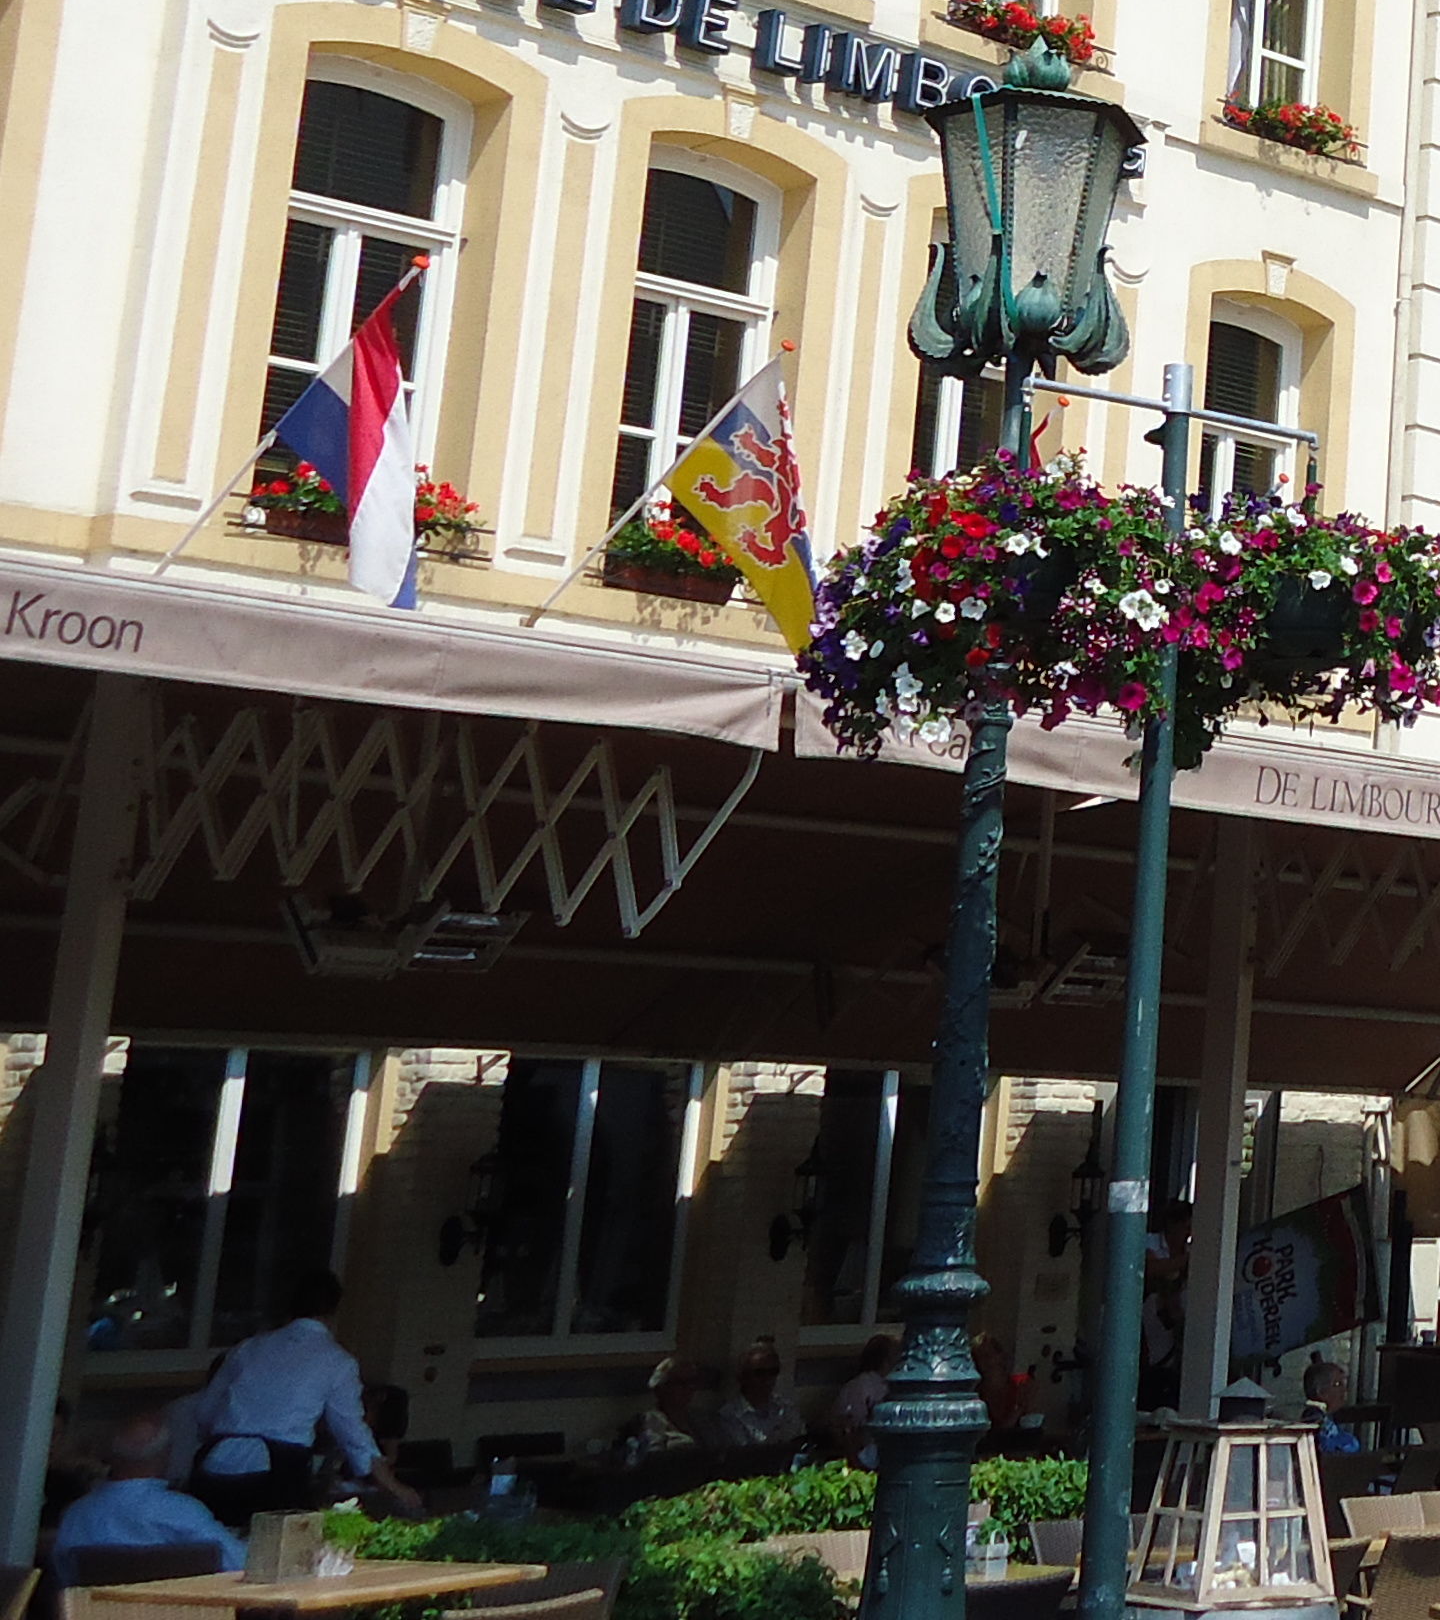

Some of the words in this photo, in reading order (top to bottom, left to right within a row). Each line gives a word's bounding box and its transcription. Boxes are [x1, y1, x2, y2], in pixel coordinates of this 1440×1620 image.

[4, 590, 144, 653] Kroon
[1254, 765, 1300, 808] DE
[1275, 1243, 1297, 1306] PARK
